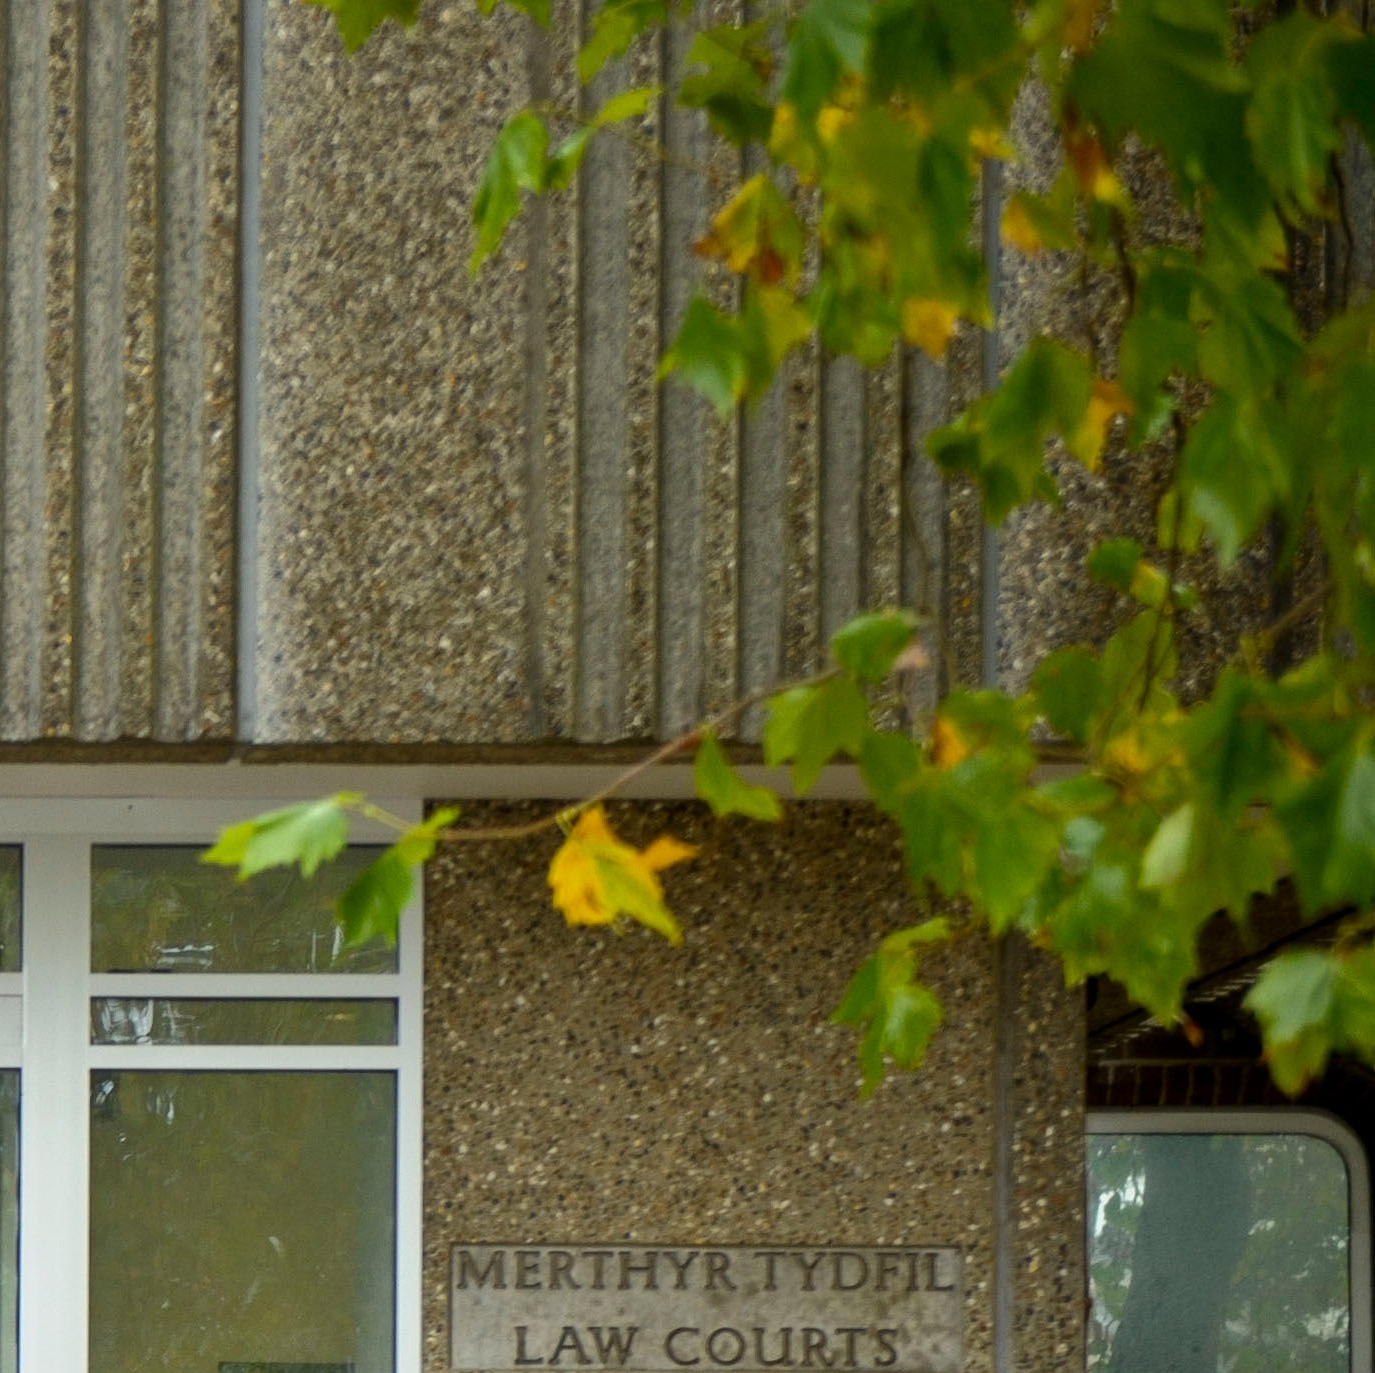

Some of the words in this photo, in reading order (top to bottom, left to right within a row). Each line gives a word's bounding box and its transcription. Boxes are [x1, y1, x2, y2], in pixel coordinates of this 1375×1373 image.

[456, 1250, 737, 1292] MERTHYR
[753, 1250, 955, 1292] TYDFIL
[513, 1325, 638, 1367] LAW
[663, 1326, 900, 1367] COURTS
